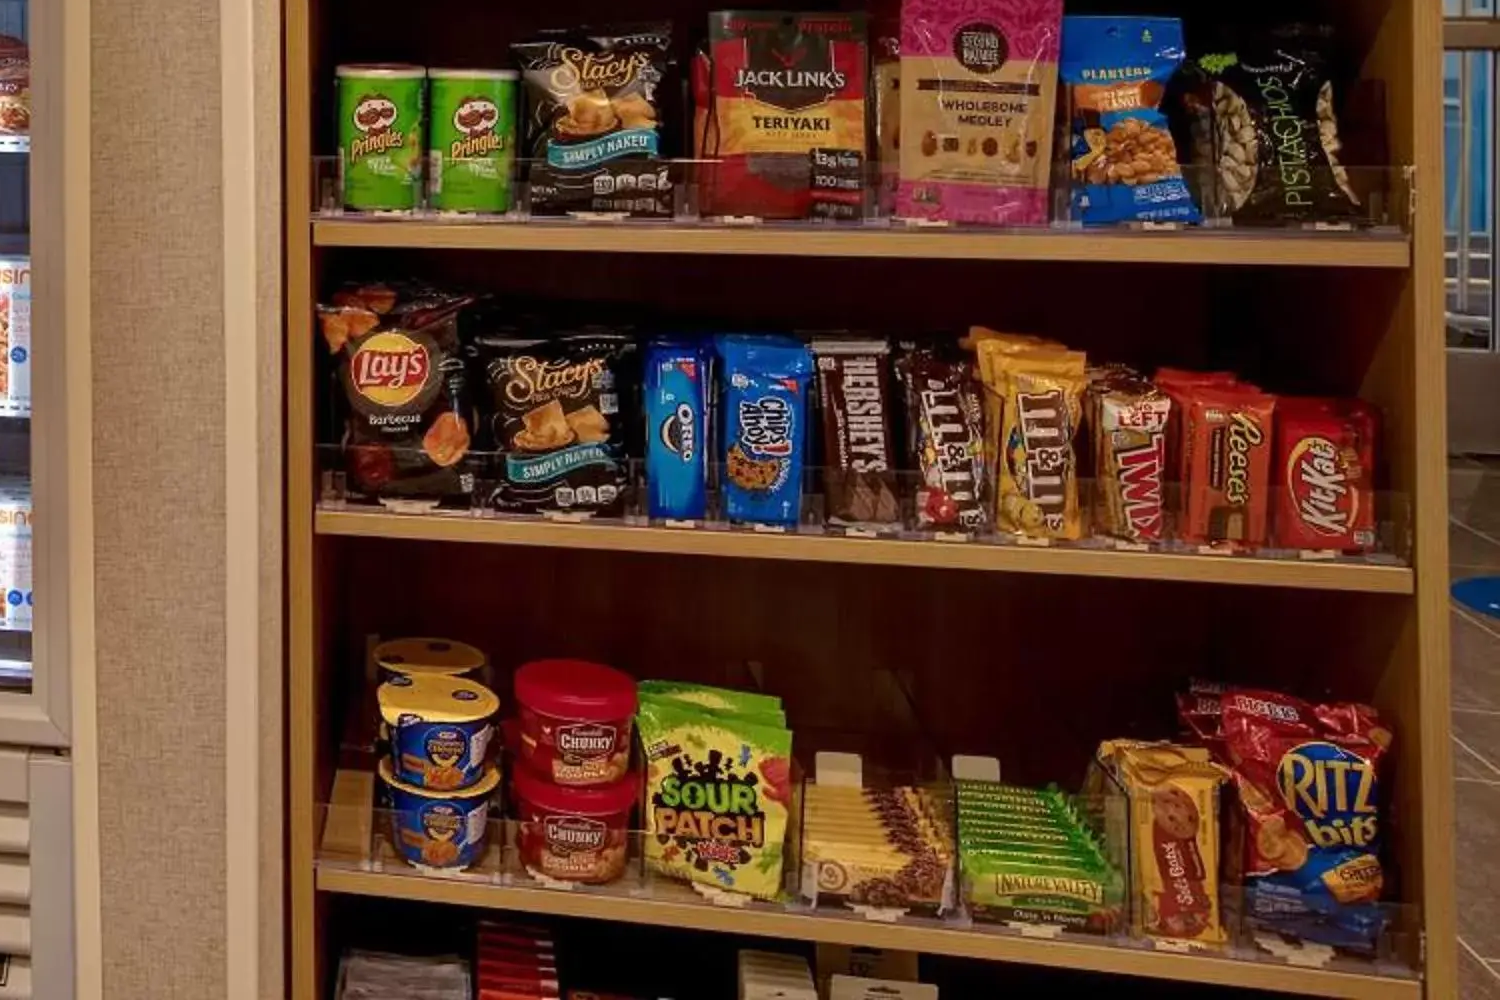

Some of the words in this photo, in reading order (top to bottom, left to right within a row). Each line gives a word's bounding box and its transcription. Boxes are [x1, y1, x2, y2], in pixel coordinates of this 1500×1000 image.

[550, 48, 650, 97] Stacy's
[734, 70, 785, 89] JACK
[786, 69, 845, 89] LINK'S
[752, 115, 831, 132] TERIYAKI
[941, 99, 1028, 114] WHOLESOME
[957, 114, 1013, 128] MEDLEY
[351, 129, 404, 163] Pringles
[451, 133, 504, 164] Pringles
[505, 355, 605, 404] Stacy's
[677, 403, 695, 463] OREO
[842, 358, 888, 474] HERSHEY'S
[1226, 413, 1262, 504] Reese's
[1115, 434, 1165, 543] TWIX
[560, 733, 615, 751] CHUNKY
[660, 777, 759, 816] SOUR
[1283, 752, 1377, 819] RITZ
[547, 823, 603, 845] CHUNKY
[654, 807, 765, 848] PATCH
[1304, 815, 1378, 849] bits
